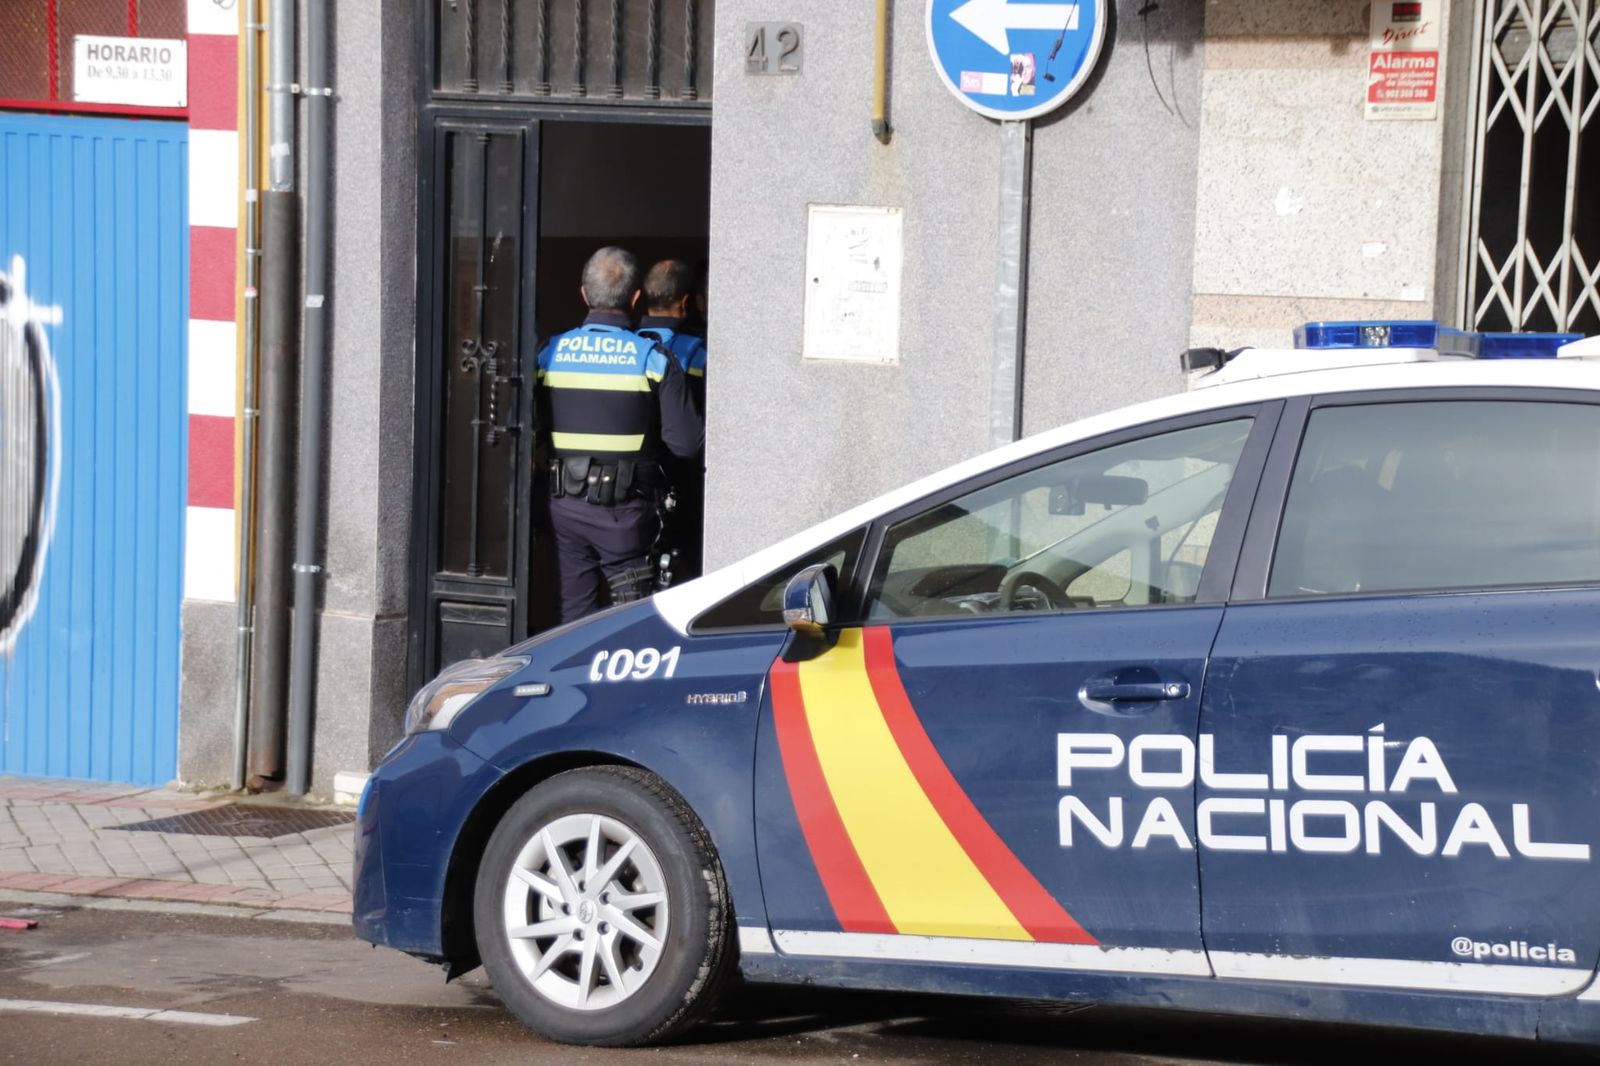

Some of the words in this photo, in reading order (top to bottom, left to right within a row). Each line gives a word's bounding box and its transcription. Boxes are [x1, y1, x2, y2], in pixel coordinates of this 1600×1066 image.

[87, 43, 172, 64] HORARIO
[746, 26, 800, 73] 42
[1372, 53, 1435, 69] Alarma
[87, 64, 102, 78] De
[556, 336, 638, 354] POLICIA
[555, 353, 637, 366] SALAMANCA
[606, 645, 681, 681] 091
[1056, 722, 1459, 793] POLICÍA
[1058, 795, 1591, 860] NACIONAL
[1450, 936, 1577, 962] @policia
